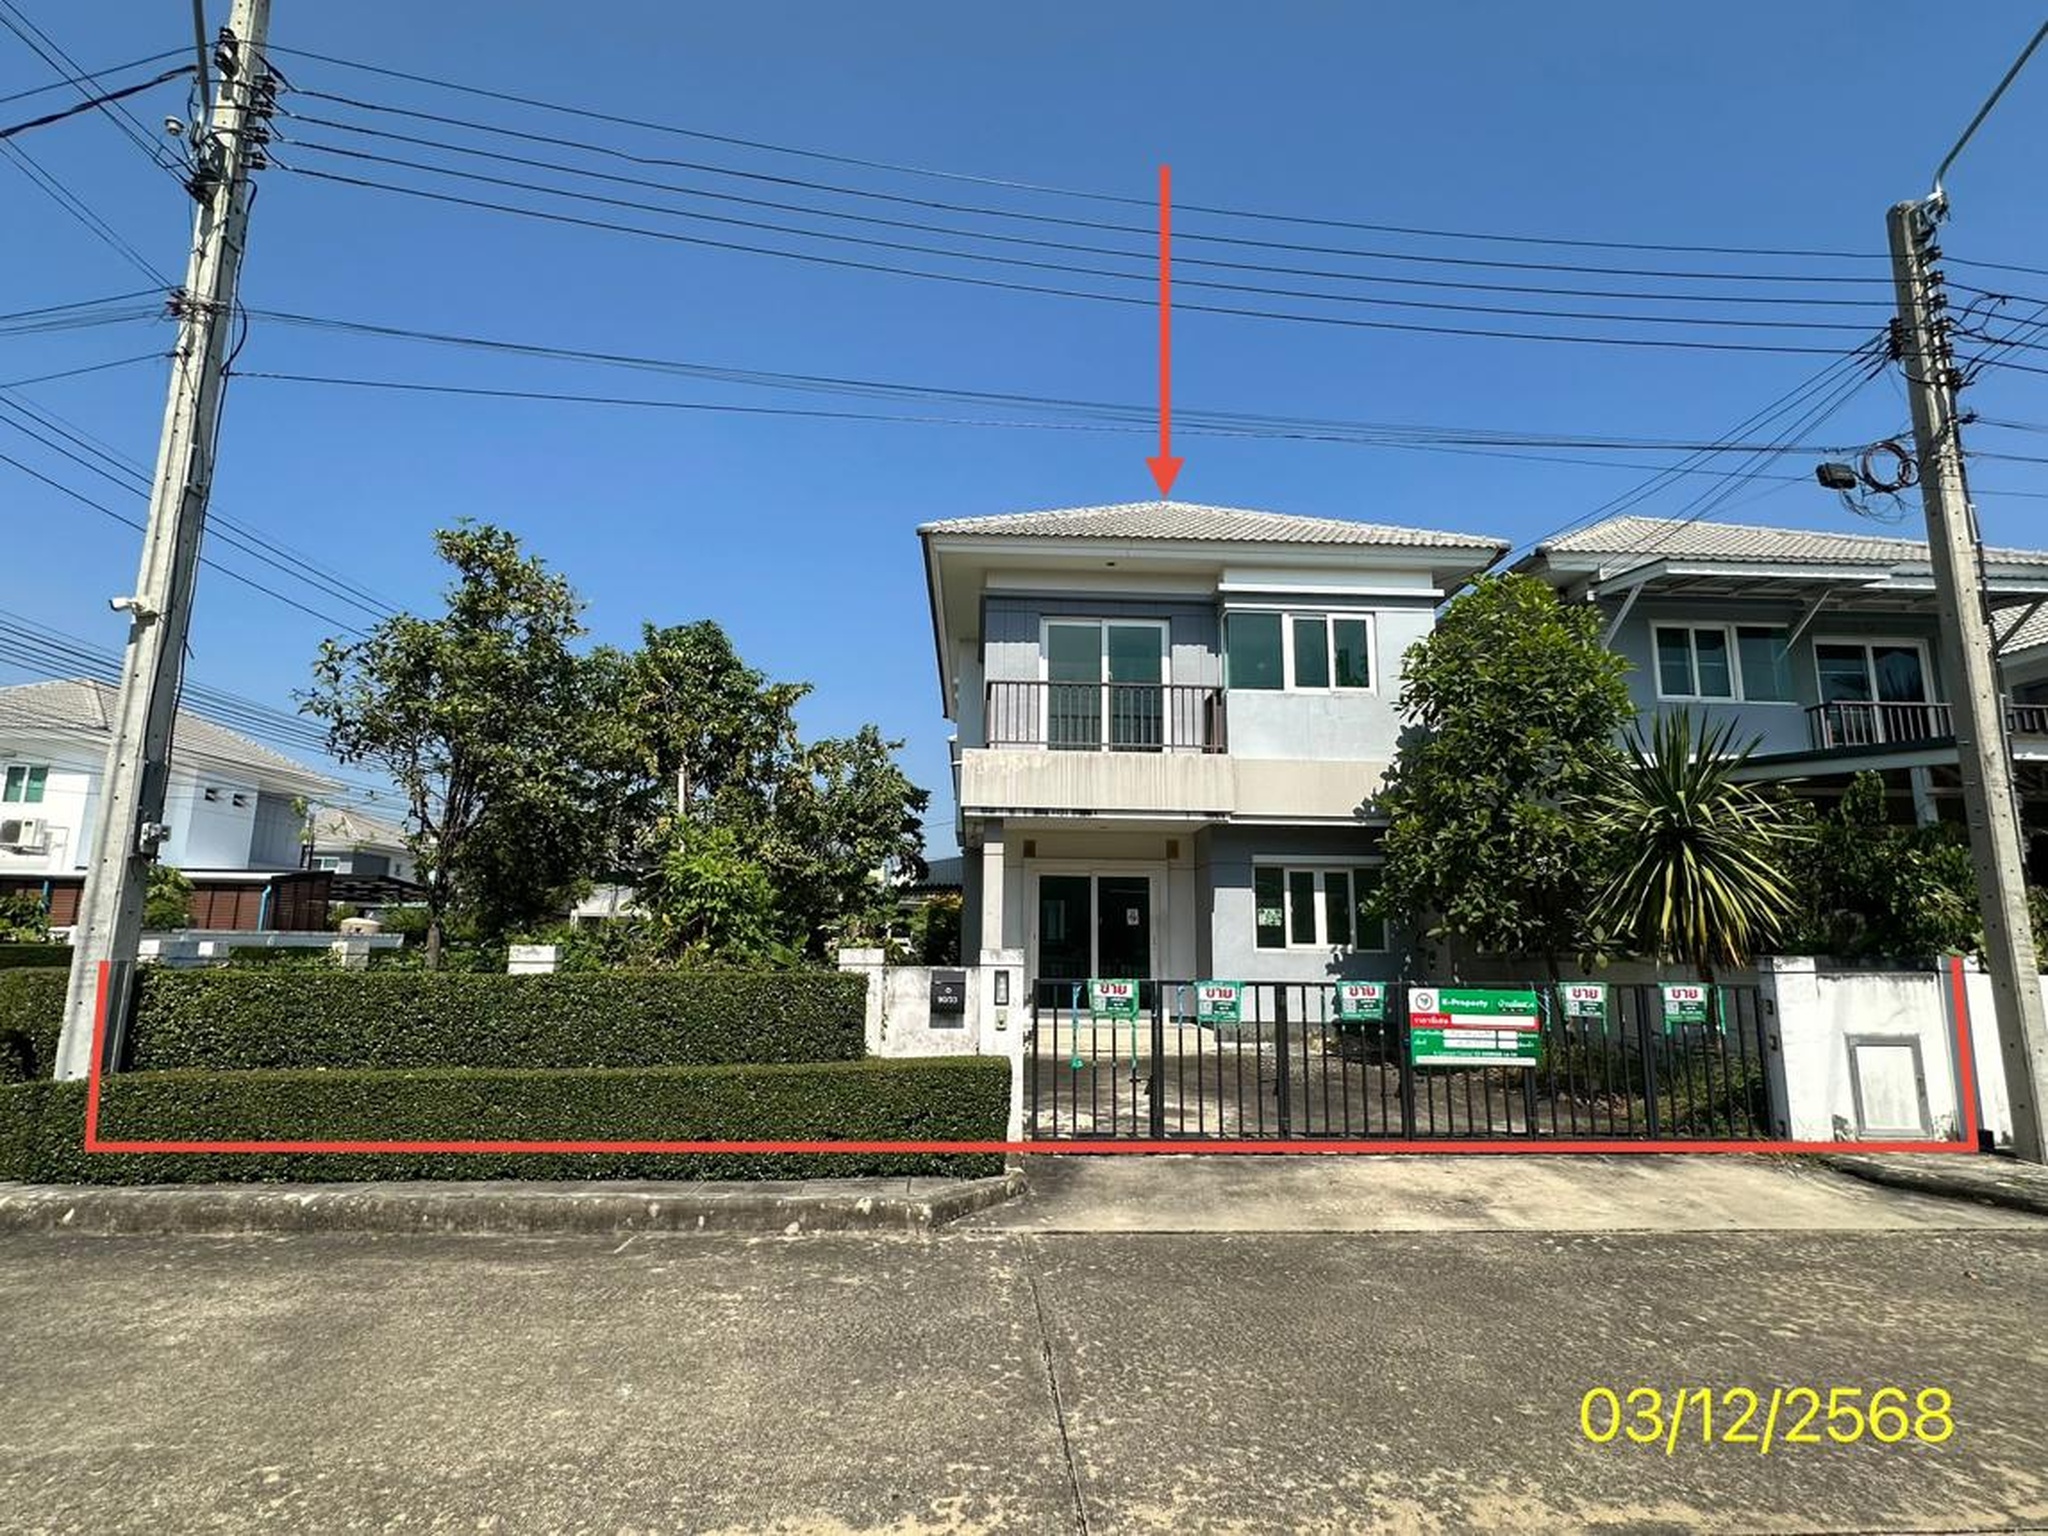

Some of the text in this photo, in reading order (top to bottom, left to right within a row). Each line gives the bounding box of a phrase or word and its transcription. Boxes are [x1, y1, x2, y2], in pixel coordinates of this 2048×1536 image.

[1100, 983, 1128, 995] ขาย
[1206, 987, 1233, 999] ขาย
[1349, 985, 1376, 997] ขาย
[1572, 987, 1598, 999] ขาย
[1671, 987, 1698, 999] ขาย
